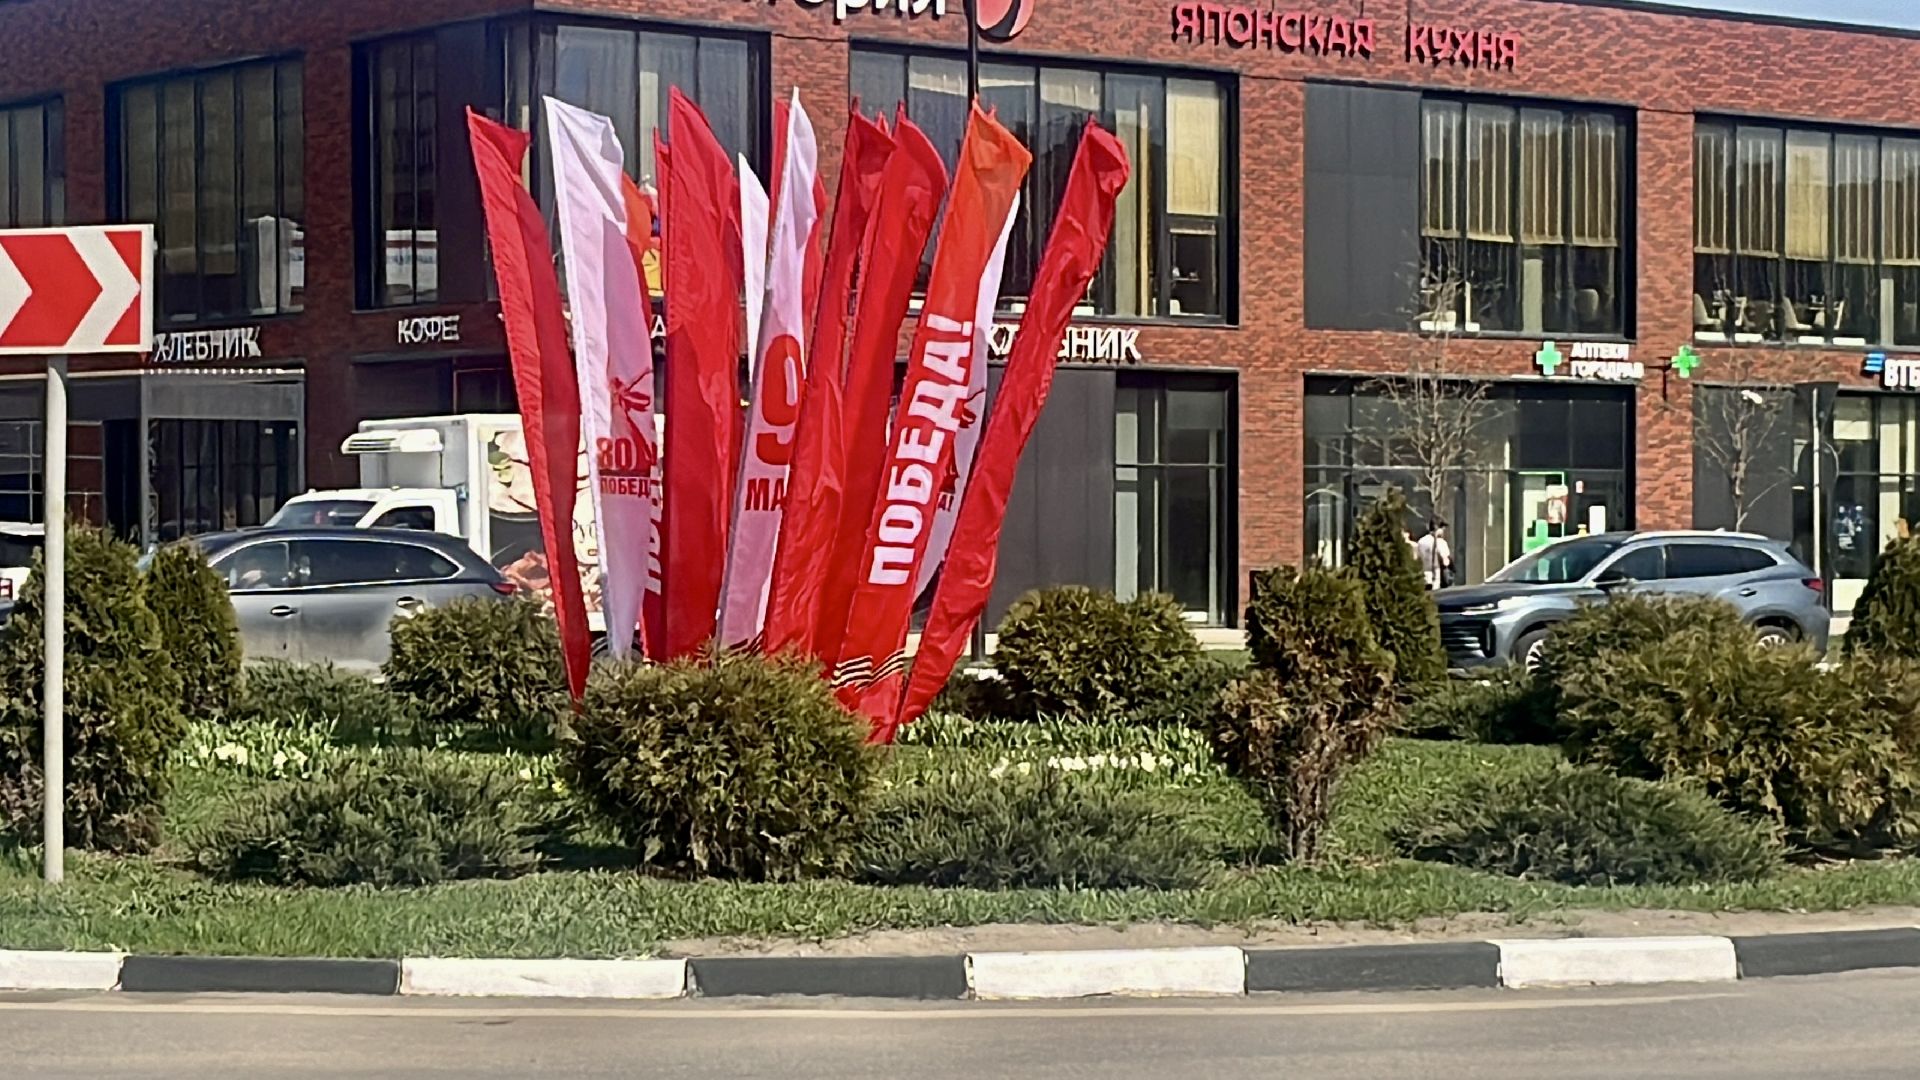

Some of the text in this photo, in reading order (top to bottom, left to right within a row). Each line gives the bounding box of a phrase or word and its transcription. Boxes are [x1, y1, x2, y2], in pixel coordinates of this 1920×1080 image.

[1174, 3, 1519, 66] ЯПОНСКАЯ КУХНЯ
[153, 326, 262, 362] ХЛЕБНИК
[398, 315, 460, 343] КОФЕ
[1884, 359, 1920, 388] ВТБ
[756, 334, 801, 466] 9
[596, 437, 633, 469] 80
[868, 313, 973, 585] ПОБЕДА!
[600, 477, 651, 499] ПОБЕД
[744, 478, 787, 511] МА
